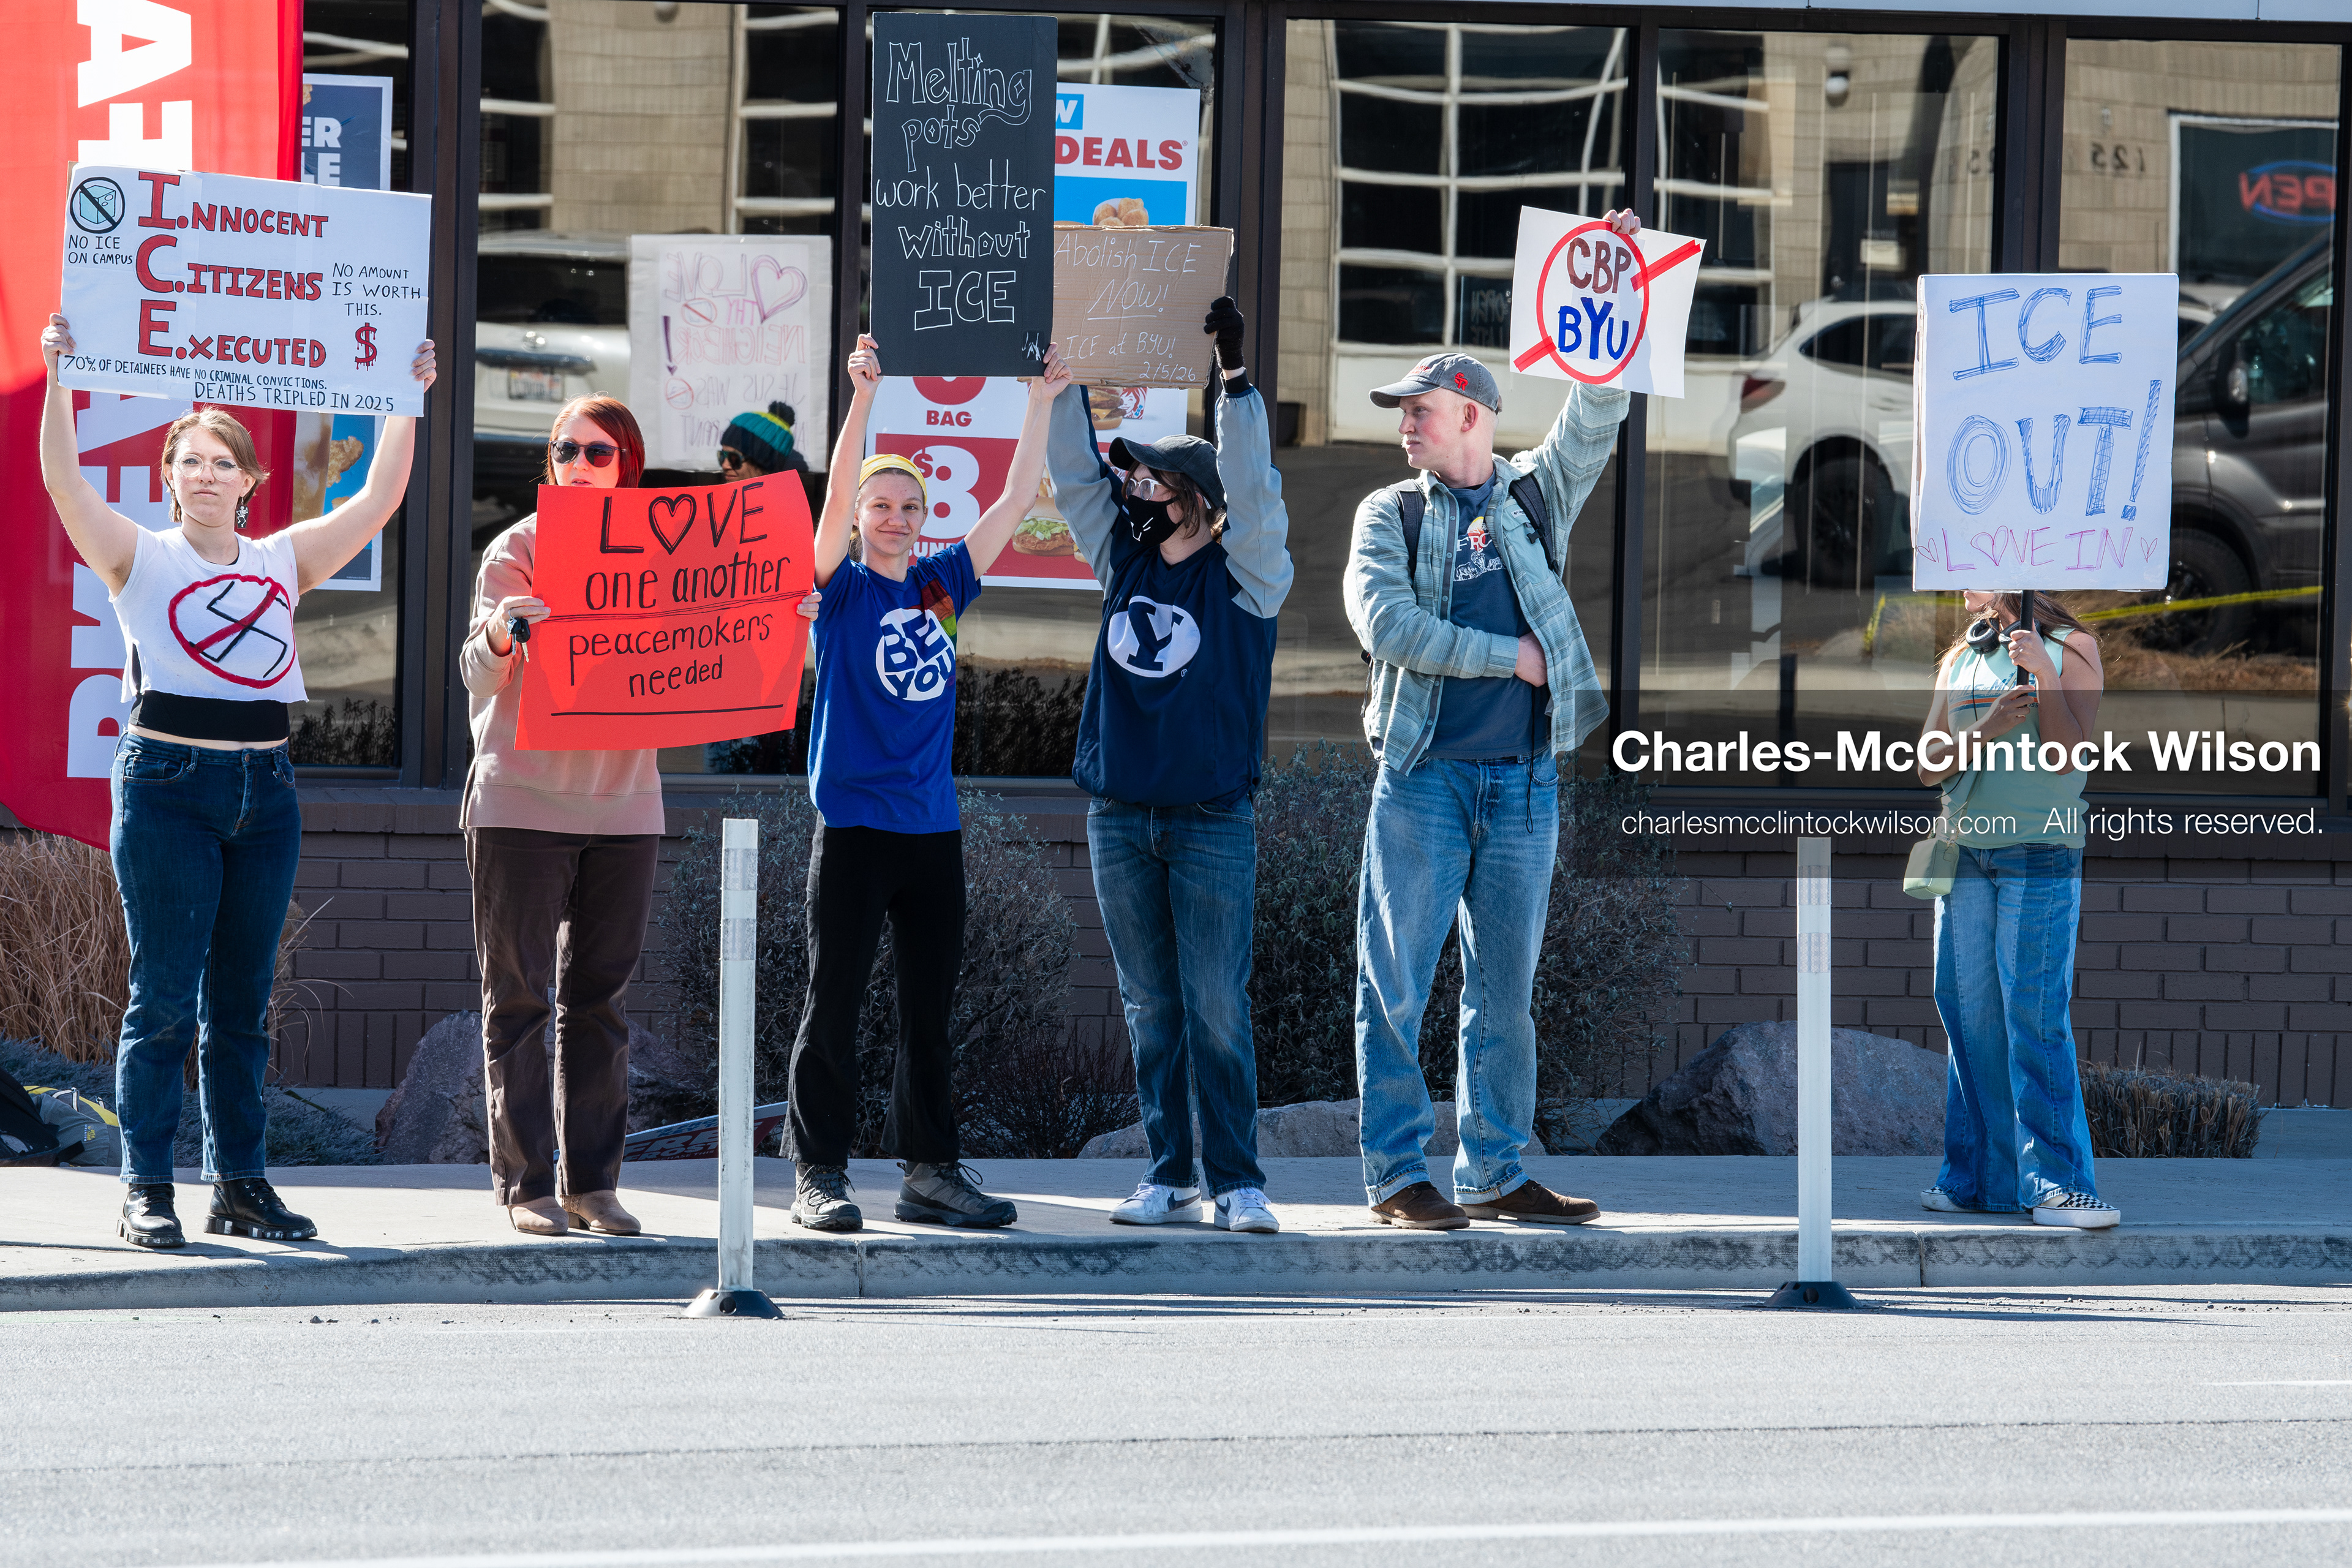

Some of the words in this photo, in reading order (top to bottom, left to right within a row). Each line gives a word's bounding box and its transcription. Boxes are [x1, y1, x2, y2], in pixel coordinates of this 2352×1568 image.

[886, 37, 1032, 126] Melting
[902, 104, 981, 173] pots
[876, 165, 939, 209] work
[954, 159, 1046, 211] better
[68, 252, 88, 264] ON
[92, 253, 133, 265] CAMPUS
[69, 234, 88, 249] NO
[95, 236, 121, 250] ICE
[898, 215, 1030, 260] without
[1054, 233, 1137, 269] Abolish
[1142, 241, 1201, 272] ICE
[333, 262, 353, 277] NO
[358, 266, 409, 279] AMOUNT
[1567, 237, 1632, 294] CBP
[332, 282, 352, 296] IS
[363, 284, 421, 299] WORTH
[344, 303, 382, 316] THIS.
[914, 270, 1017, 331] ICE
[1087, 278, 1169, 314] NOW!
[1062, 335, 1101, 360] ICE
[1109, 332, 1127, 355] at
[1137, 331, 1176, 358] BYU!
[1558, 297, 1629, 360] BYU
[1948, 285, 2123, 380] ICE
[99, 359, 111, 371] OF
[115, 360, 167, 375] DETAINEES
[170, 365, 191, 379] HAVE
[195, 369, 207, 380] NO
[209, 370, 253, 385] CRIMINAL
[256, 375, 327, 390] CONVICTIONS.
[1139, 361, 1196, 383] 2/5/26
[195, 382, 256, 401] DEATHS
[262, 388, 325, 407] TRIPLED
[330, 392, 349, 409] IN
[354, 395, 394, 412] 2025
[926, 410, 973, 428] BAG
[1945, 379, 2163, 521] OUT!
[2064, 527, 2134, 571] IN
[586, 569, 658, 610] one
[672, 551, 791, 603] another
[881, 612, 949, 673] BE
[629, 654, 723, 698] needed
[884, 647, 956, 699] YOU
